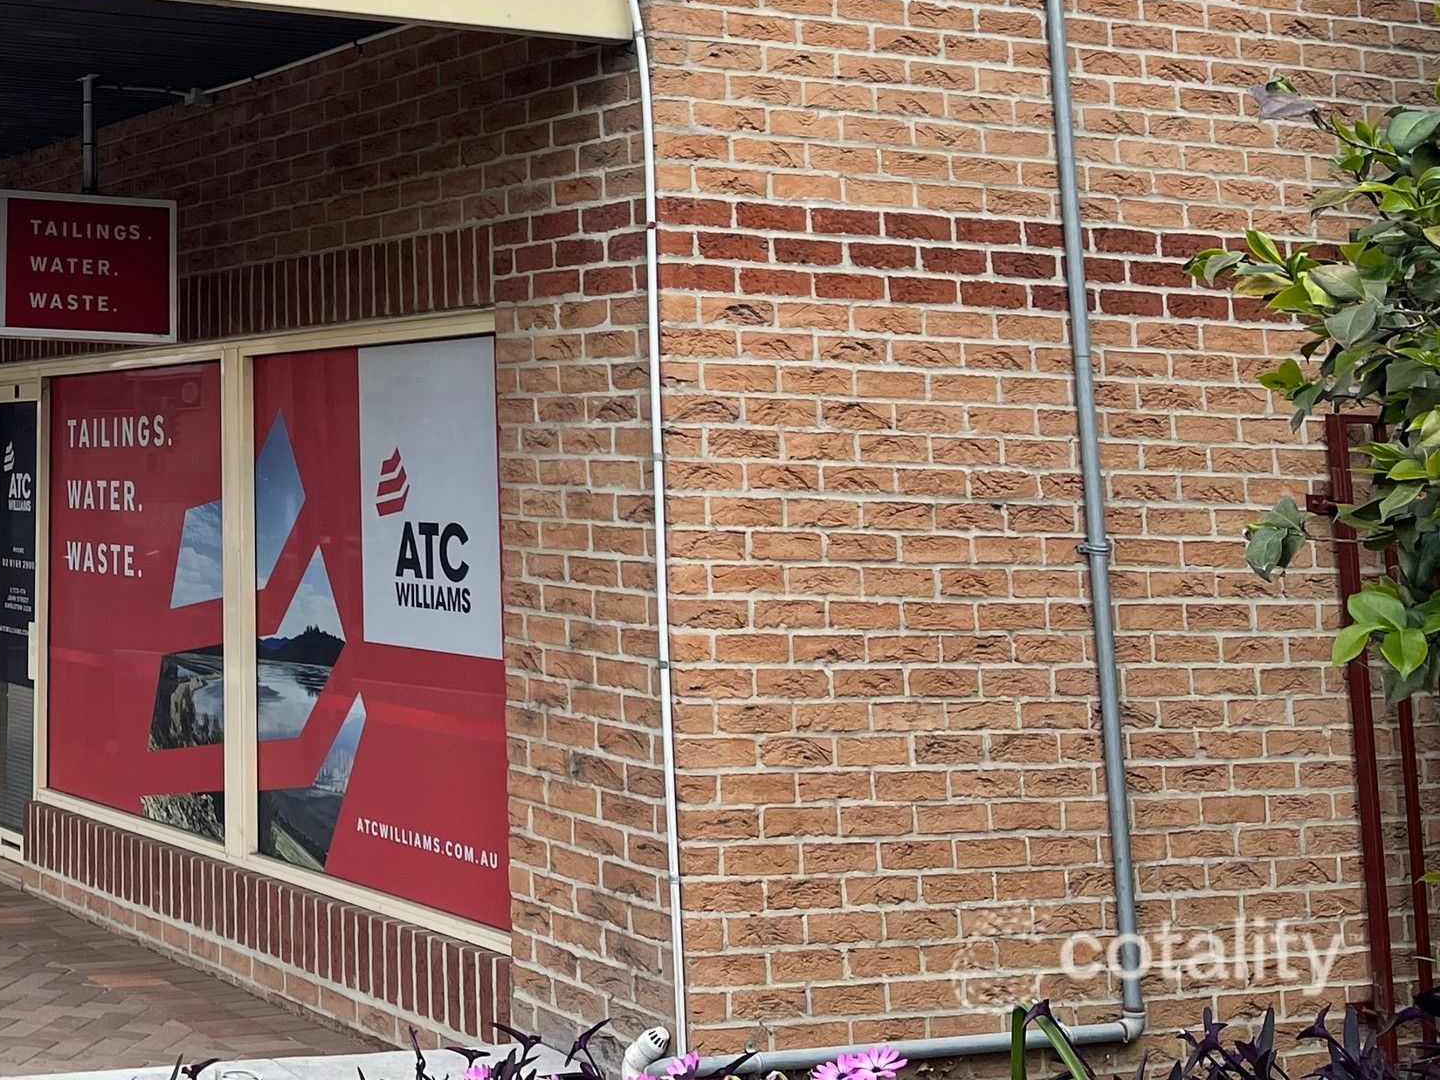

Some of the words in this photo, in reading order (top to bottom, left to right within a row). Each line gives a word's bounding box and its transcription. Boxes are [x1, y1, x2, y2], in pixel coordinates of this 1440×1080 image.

[30, 219, 152, 240] TAILINGS.
[30, 255, 118, 276] WATER.
[29, 292, 117, 312] WASTE.
[67, 414, 173, 448] TAILINGS.
[8, 472, 31, 499] ATC
[67, 479, 143, 512] WATER.
[66, 541, 143, 578] WASTE.
[395, 521, 470, 583] ATC
[395, 581, 471, 614] WILLIAMS
[356, 817, 499, 870] ATCWILLIAMS.COM.AU
